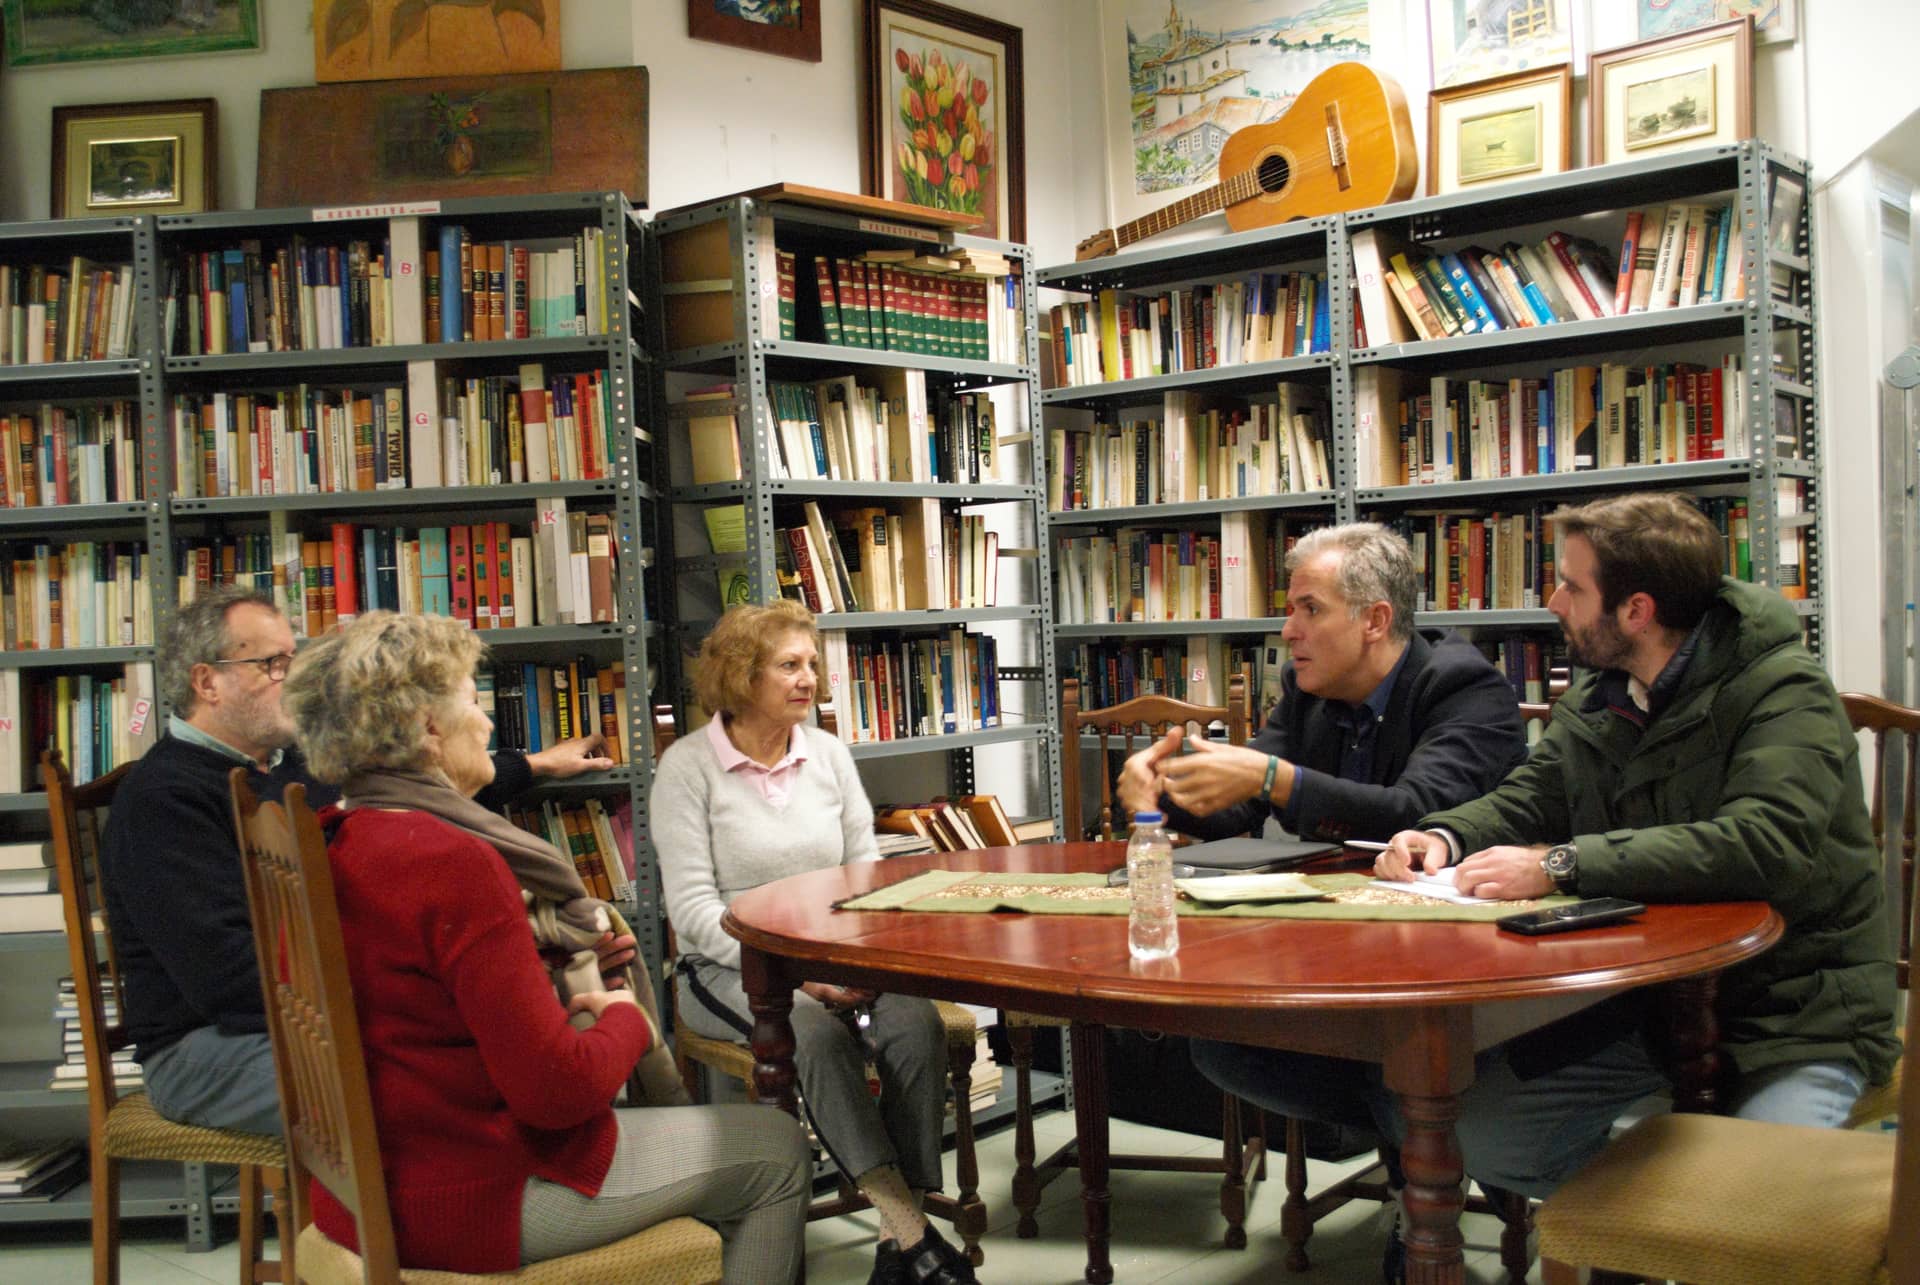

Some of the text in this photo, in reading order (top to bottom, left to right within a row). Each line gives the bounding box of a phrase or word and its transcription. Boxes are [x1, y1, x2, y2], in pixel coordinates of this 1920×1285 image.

[401, 263, 412, 274] B
[415, 412, 428, 425] G
[388, 428, 402, 478] CHACAL
[1074, 455, 1082, 490] BANCO
[543, 511, 557, 524] K
[1227, 556, 1240, 567] M
